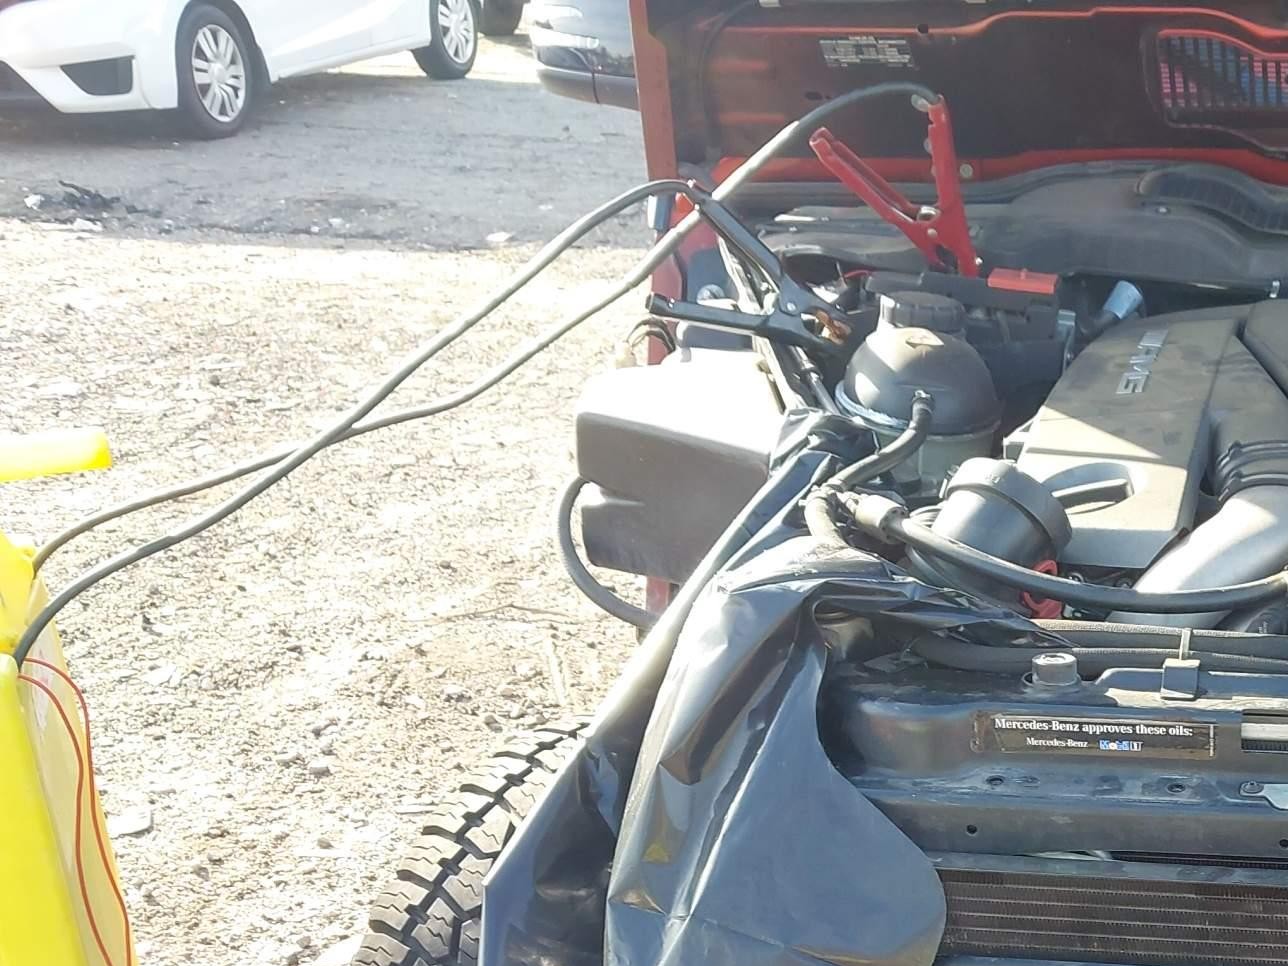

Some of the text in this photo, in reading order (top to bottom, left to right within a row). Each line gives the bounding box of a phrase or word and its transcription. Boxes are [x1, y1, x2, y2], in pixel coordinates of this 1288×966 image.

[994, 718, 1193, 737] Mercedes-Benz approves these oils:
[1026, 737, 1089, 749] Mercedes-Benz
